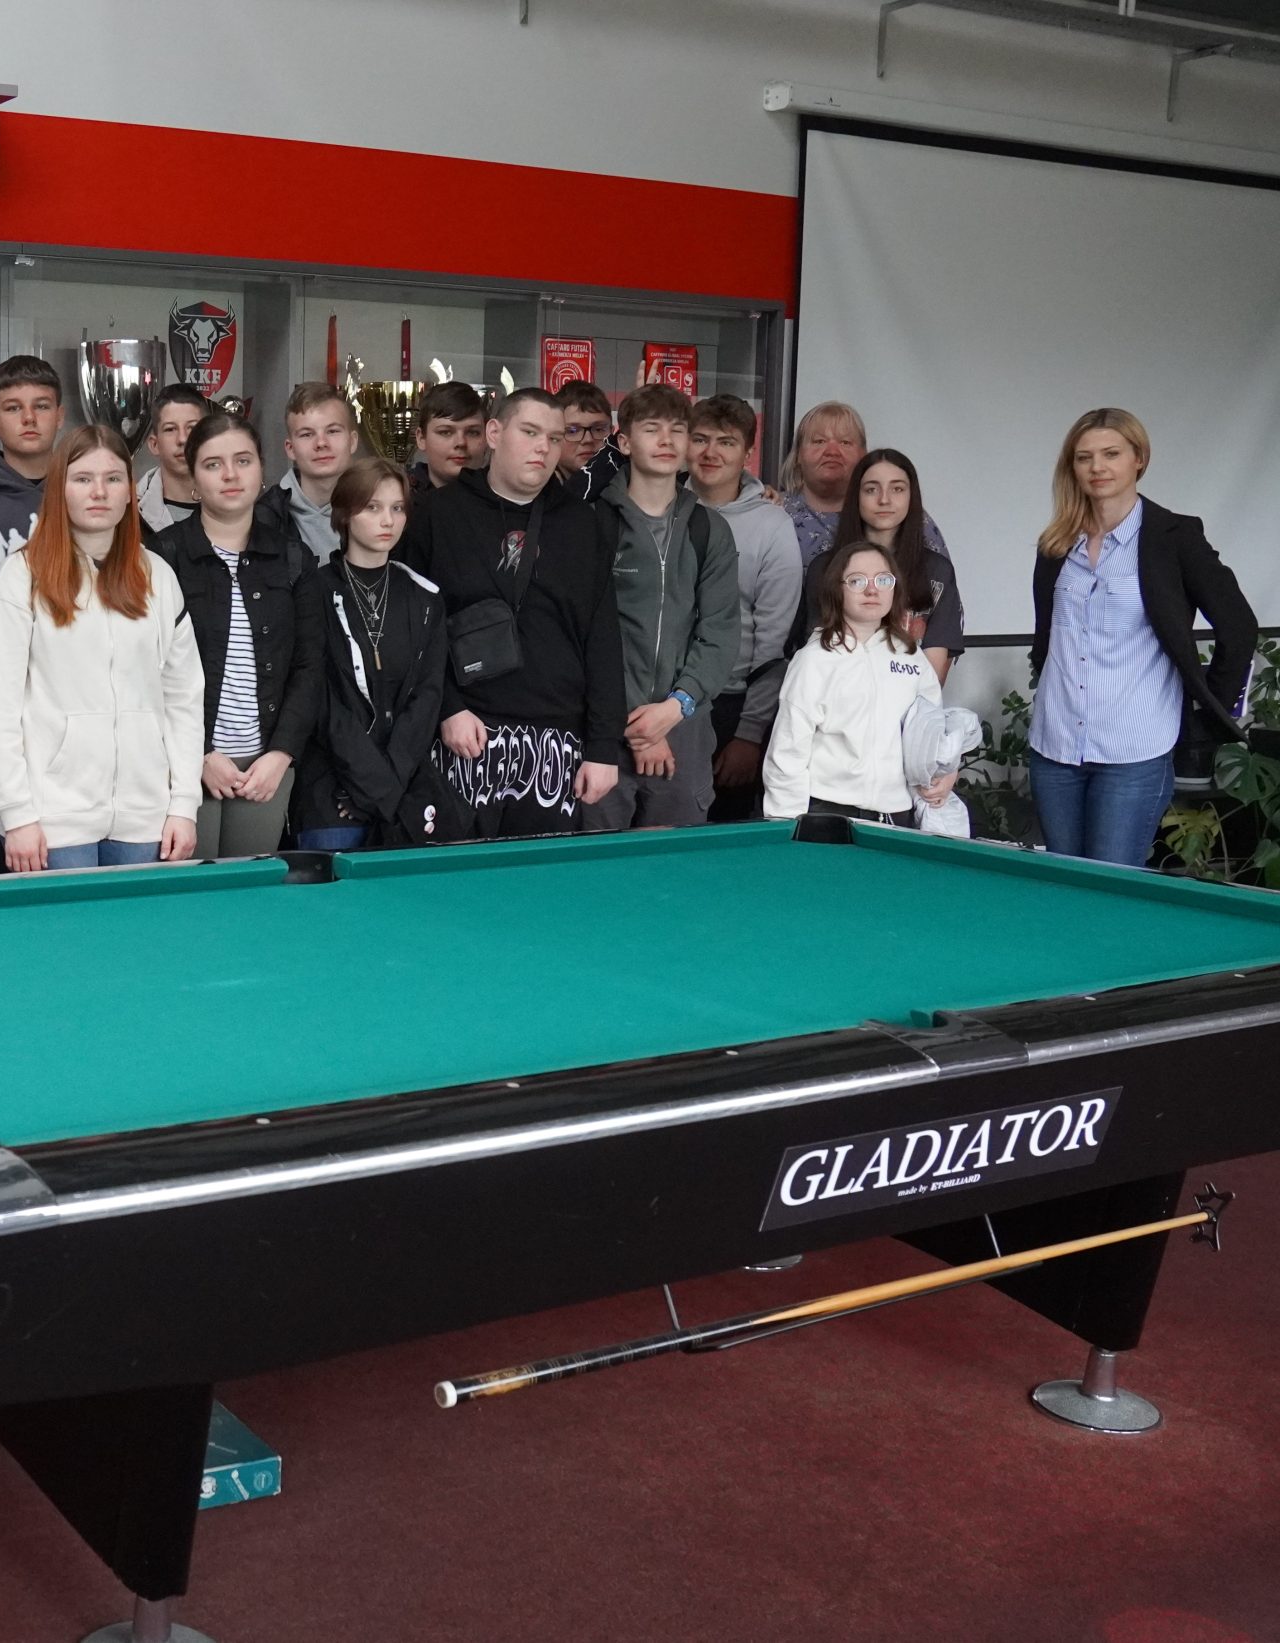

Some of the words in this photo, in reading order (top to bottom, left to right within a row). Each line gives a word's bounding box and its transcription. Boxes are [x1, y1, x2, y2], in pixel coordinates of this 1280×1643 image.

[184, 368, 222, 384] KKF
[779, 1097, 1106, 1207] GLADIATOR
[897, 1186, 918, 1197] made
[918, 1184, 928, 1194] by
